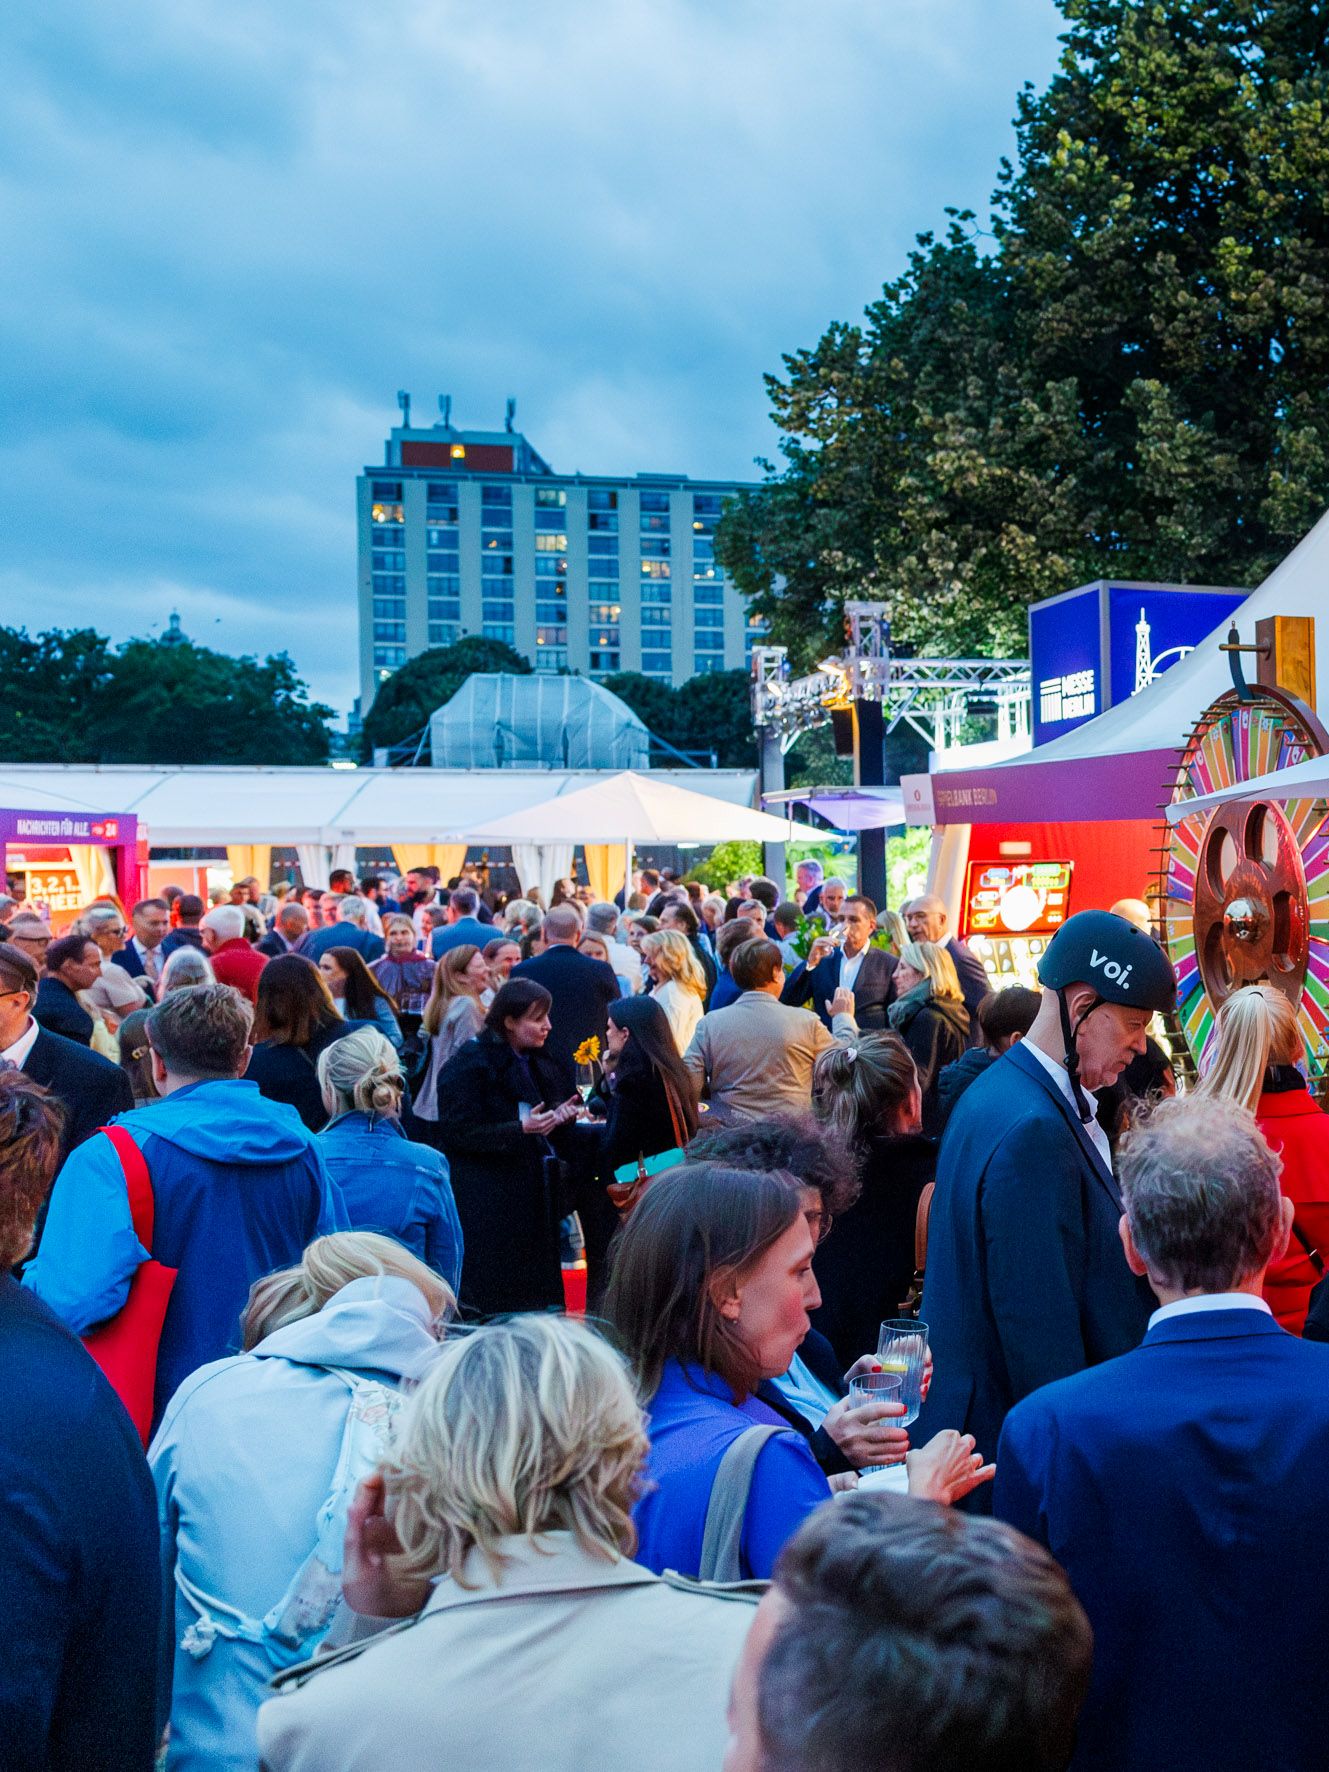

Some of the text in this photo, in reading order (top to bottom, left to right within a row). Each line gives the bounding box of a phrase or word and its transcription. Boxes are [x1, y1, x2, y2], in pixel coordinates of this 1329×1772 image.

[1062, 669, 1094, 697] MESSE
[1062, 692, 1095, 719] BERLIN
[937, 788, 997, 807] SPIELBANK BERLIN
[16, 819, 60, 836] NACHRICHTEN
[60, 817, 73, 836] FÜR
[1089, 949, 1133, 990] voi.
